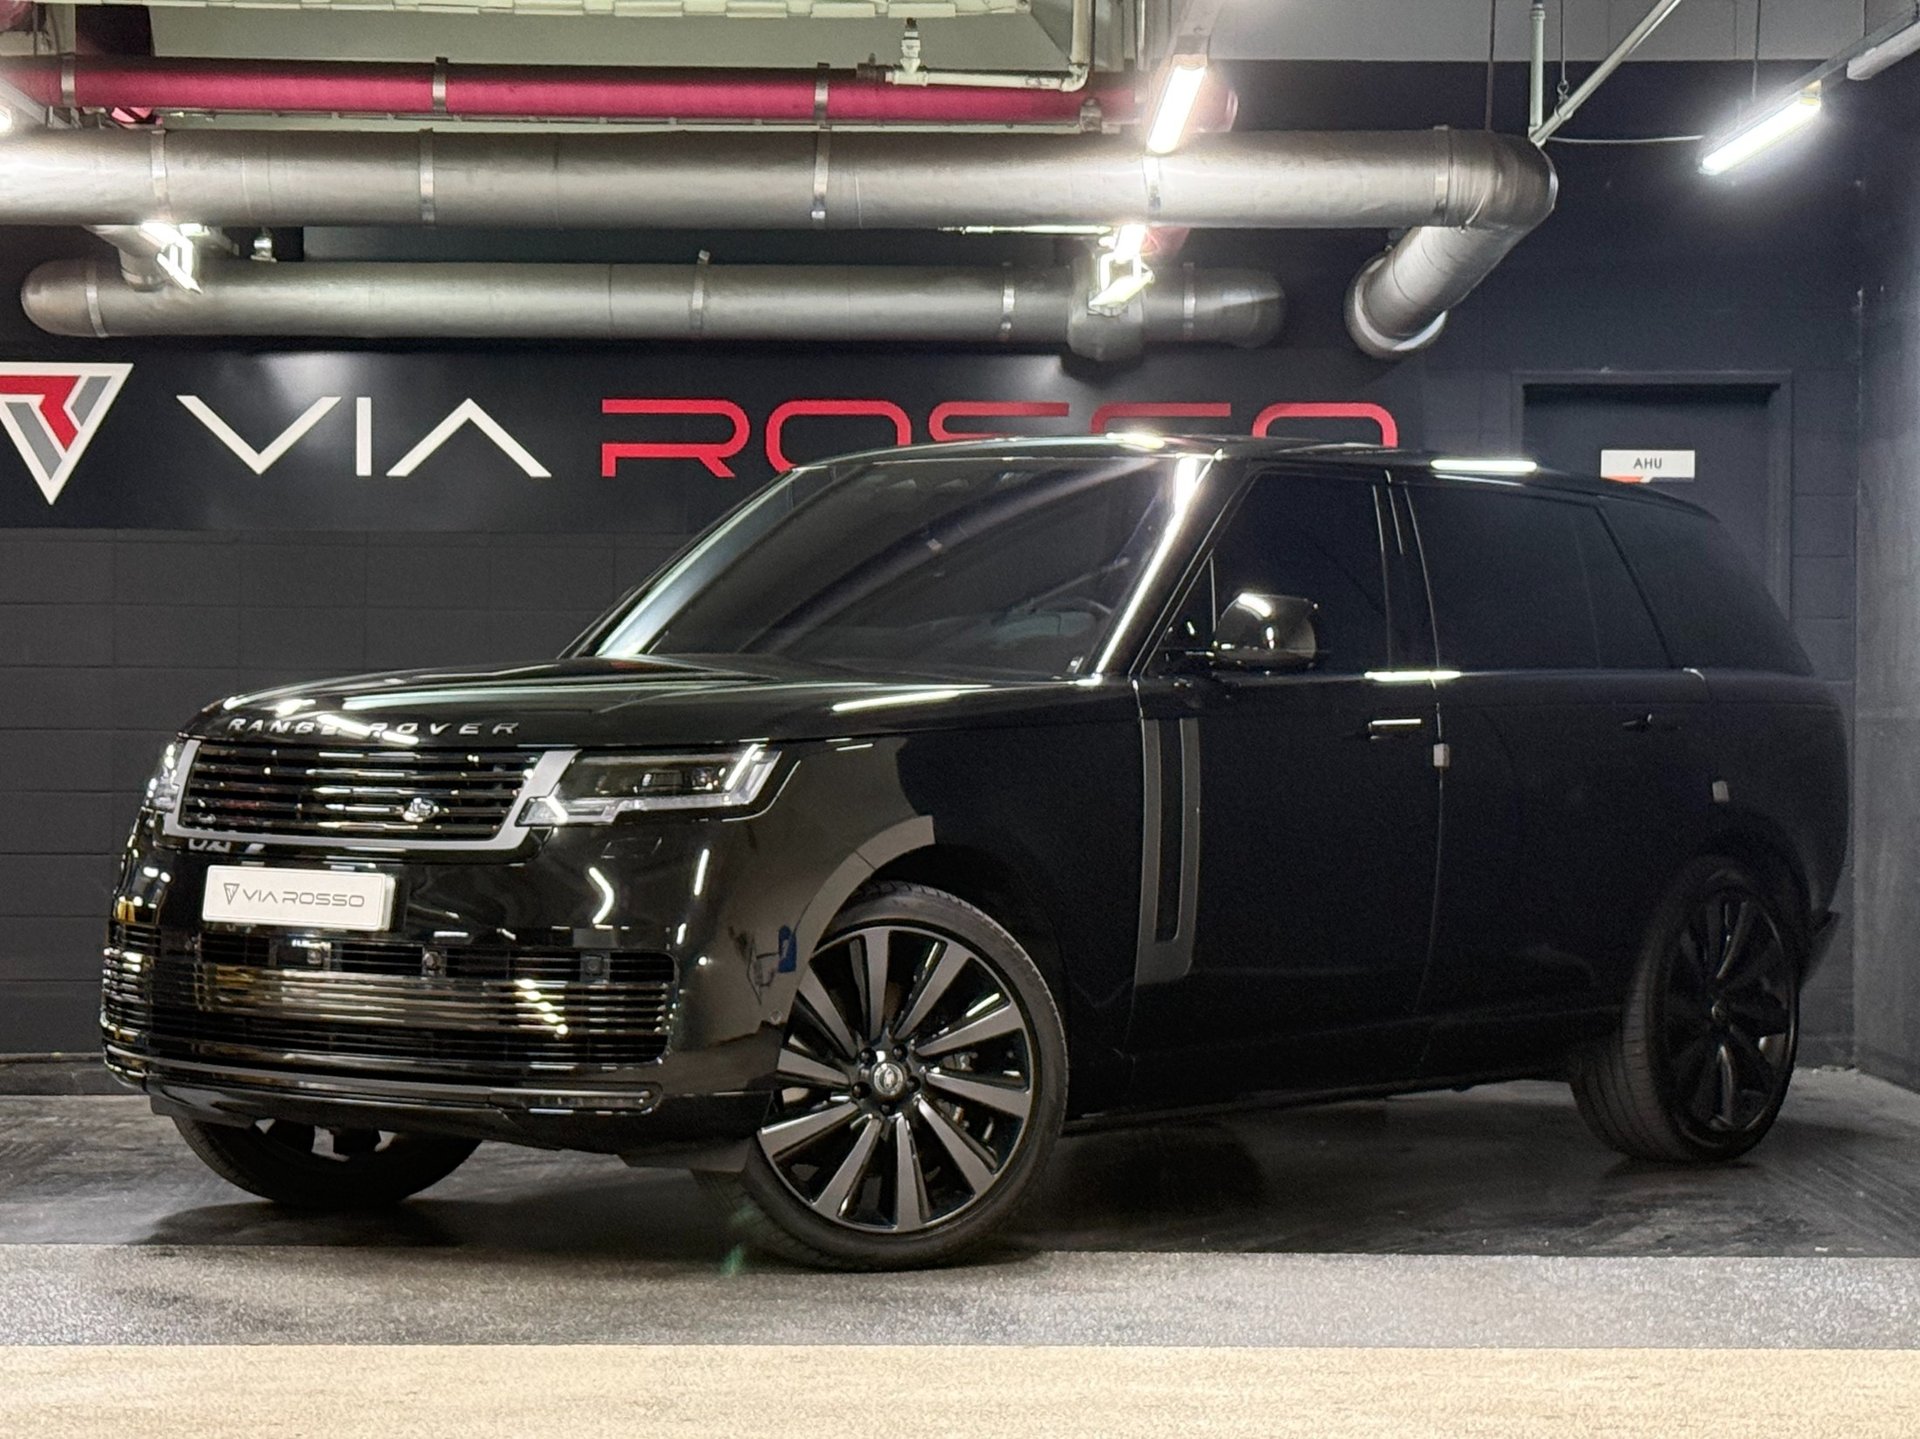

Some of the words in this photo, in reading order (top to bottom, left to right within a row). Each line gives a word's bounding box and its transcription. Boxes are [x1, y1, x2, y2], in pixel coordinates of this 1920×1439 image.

[176, 394, 553, 477] VIA
[1632, 456, 1663, 470] AHU
[366, 722, 519, 737] ROVER
[242, 888, 278, 904] VIA
[282, 891, 365, 908] ROSSO
